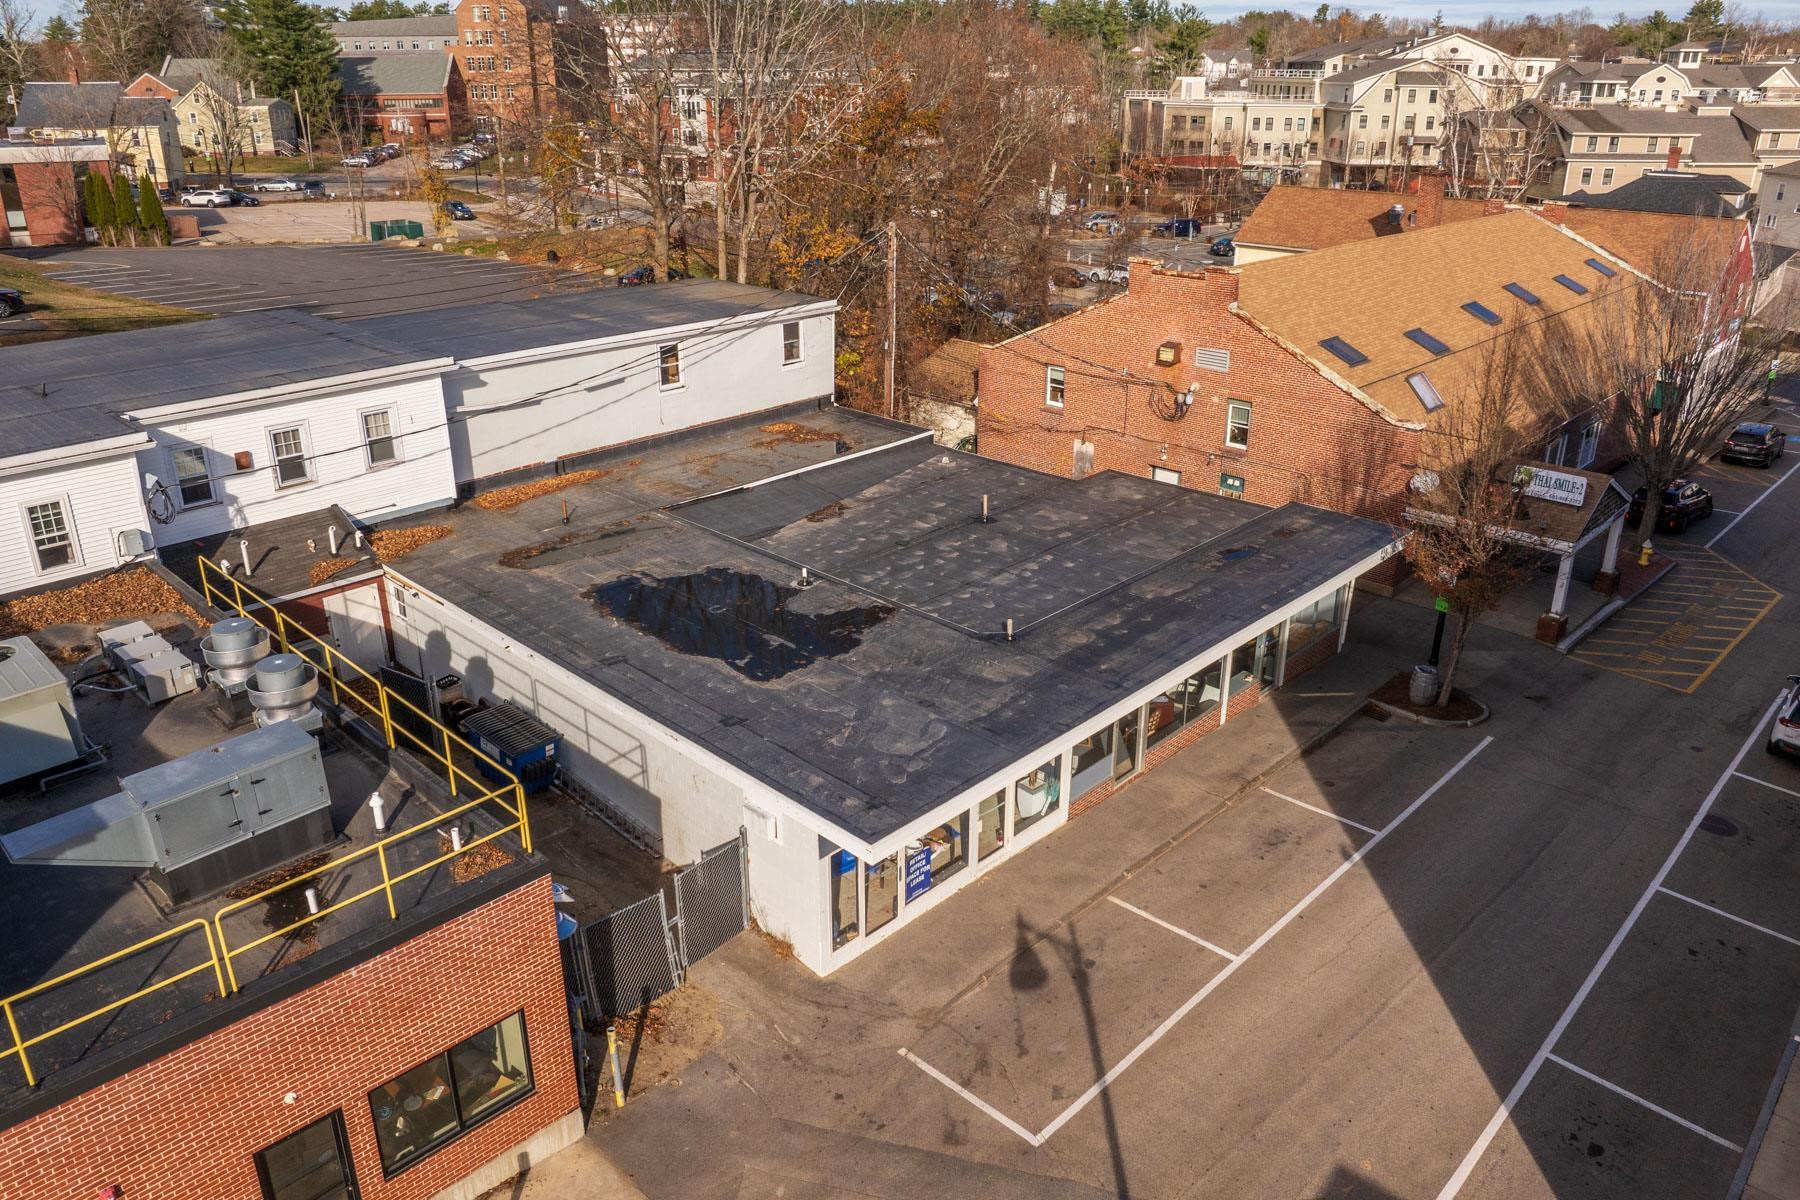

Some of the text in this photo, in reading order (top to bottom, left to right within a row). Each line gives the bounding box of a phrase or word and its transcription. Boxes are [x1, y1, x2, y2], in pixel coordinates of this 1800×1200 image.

[1534, 473, 1552, 488] THAI
[1553, 477, 1584, 495] SMILE-2
[906, 864, 931, 884] SPACE FOR
[909, 859, 926, 873] OFFICE
[911, 873, 925, 887] LEASE
